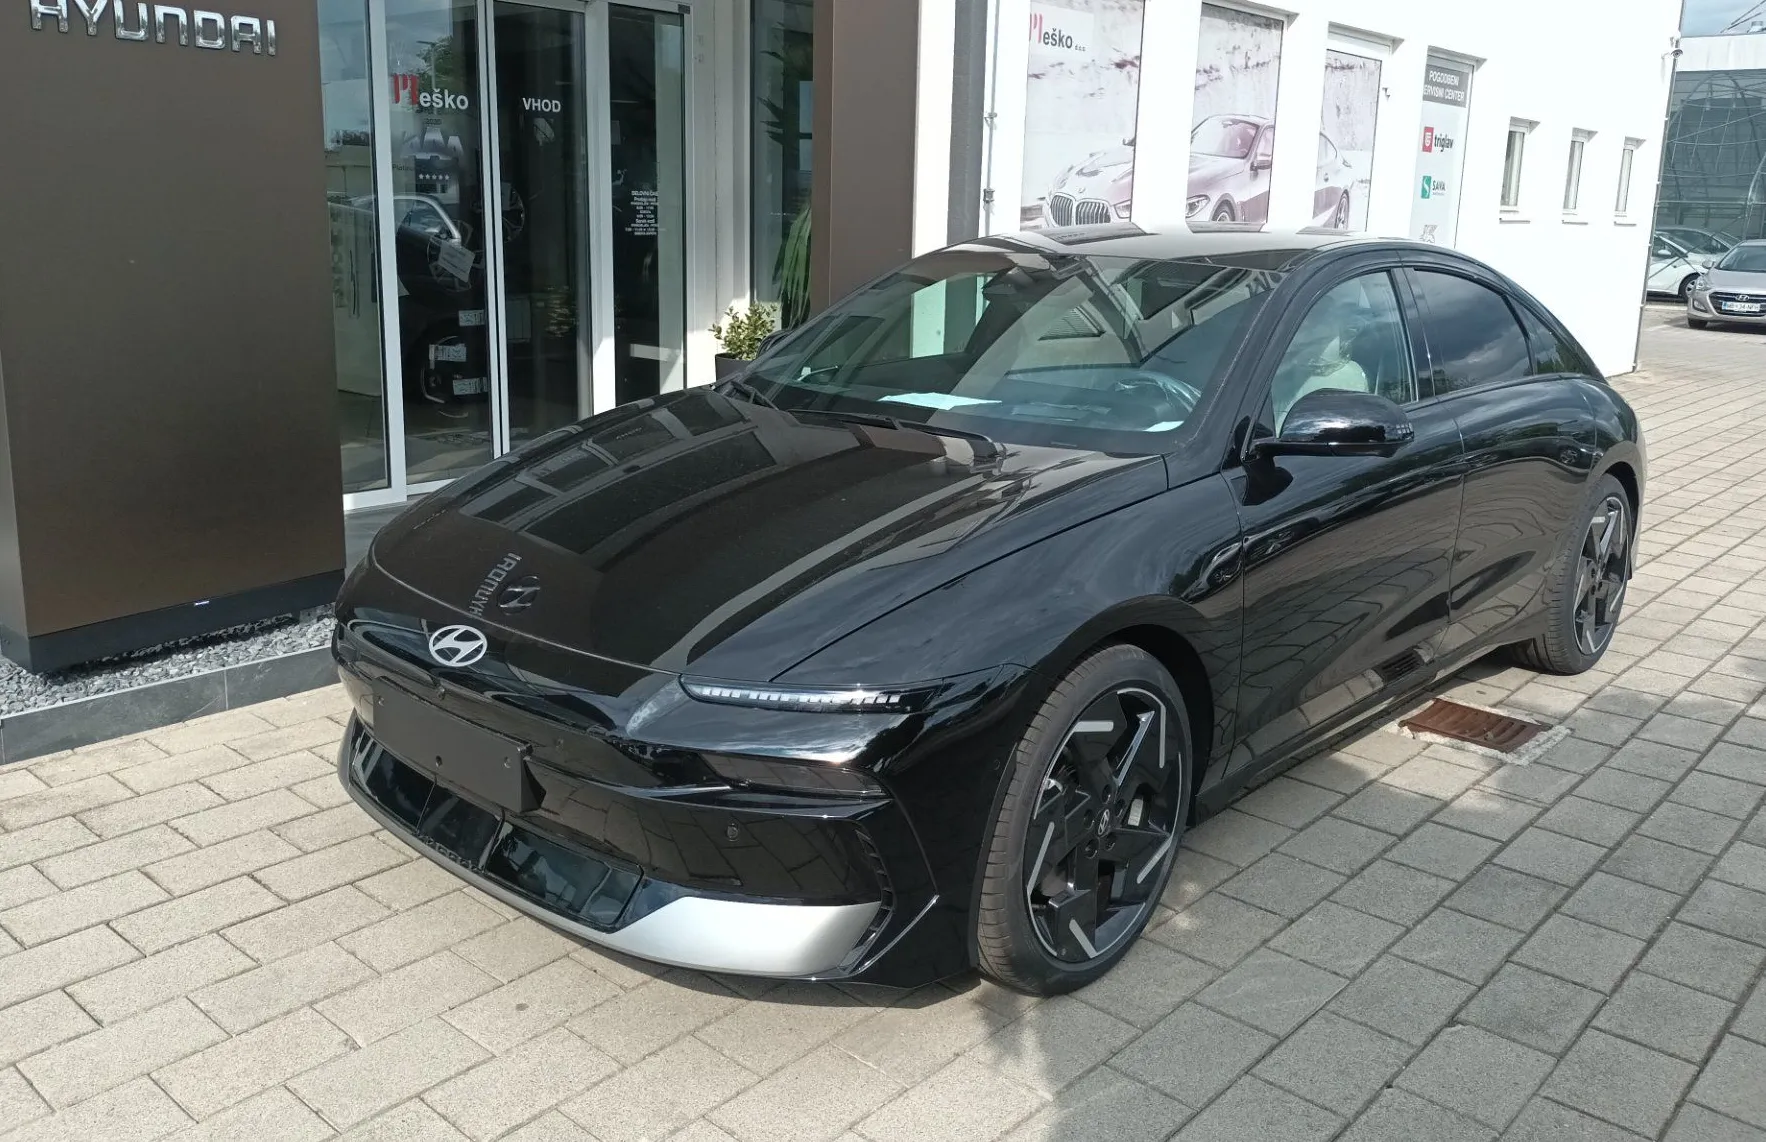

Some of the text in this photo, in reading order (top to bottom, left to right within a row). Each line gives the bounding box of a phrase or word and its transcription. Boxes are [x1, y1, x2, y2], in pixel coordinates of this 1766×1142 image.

[30, 0, 276, 57] HYUNDAI
[1423, 84, 1465, 102] ERVISNI CENTER
[522, 97, 562, 113] VHOD
[1433, 133, 1454, 152] triglav
[1432, 180, 1446, 192] SAVA
